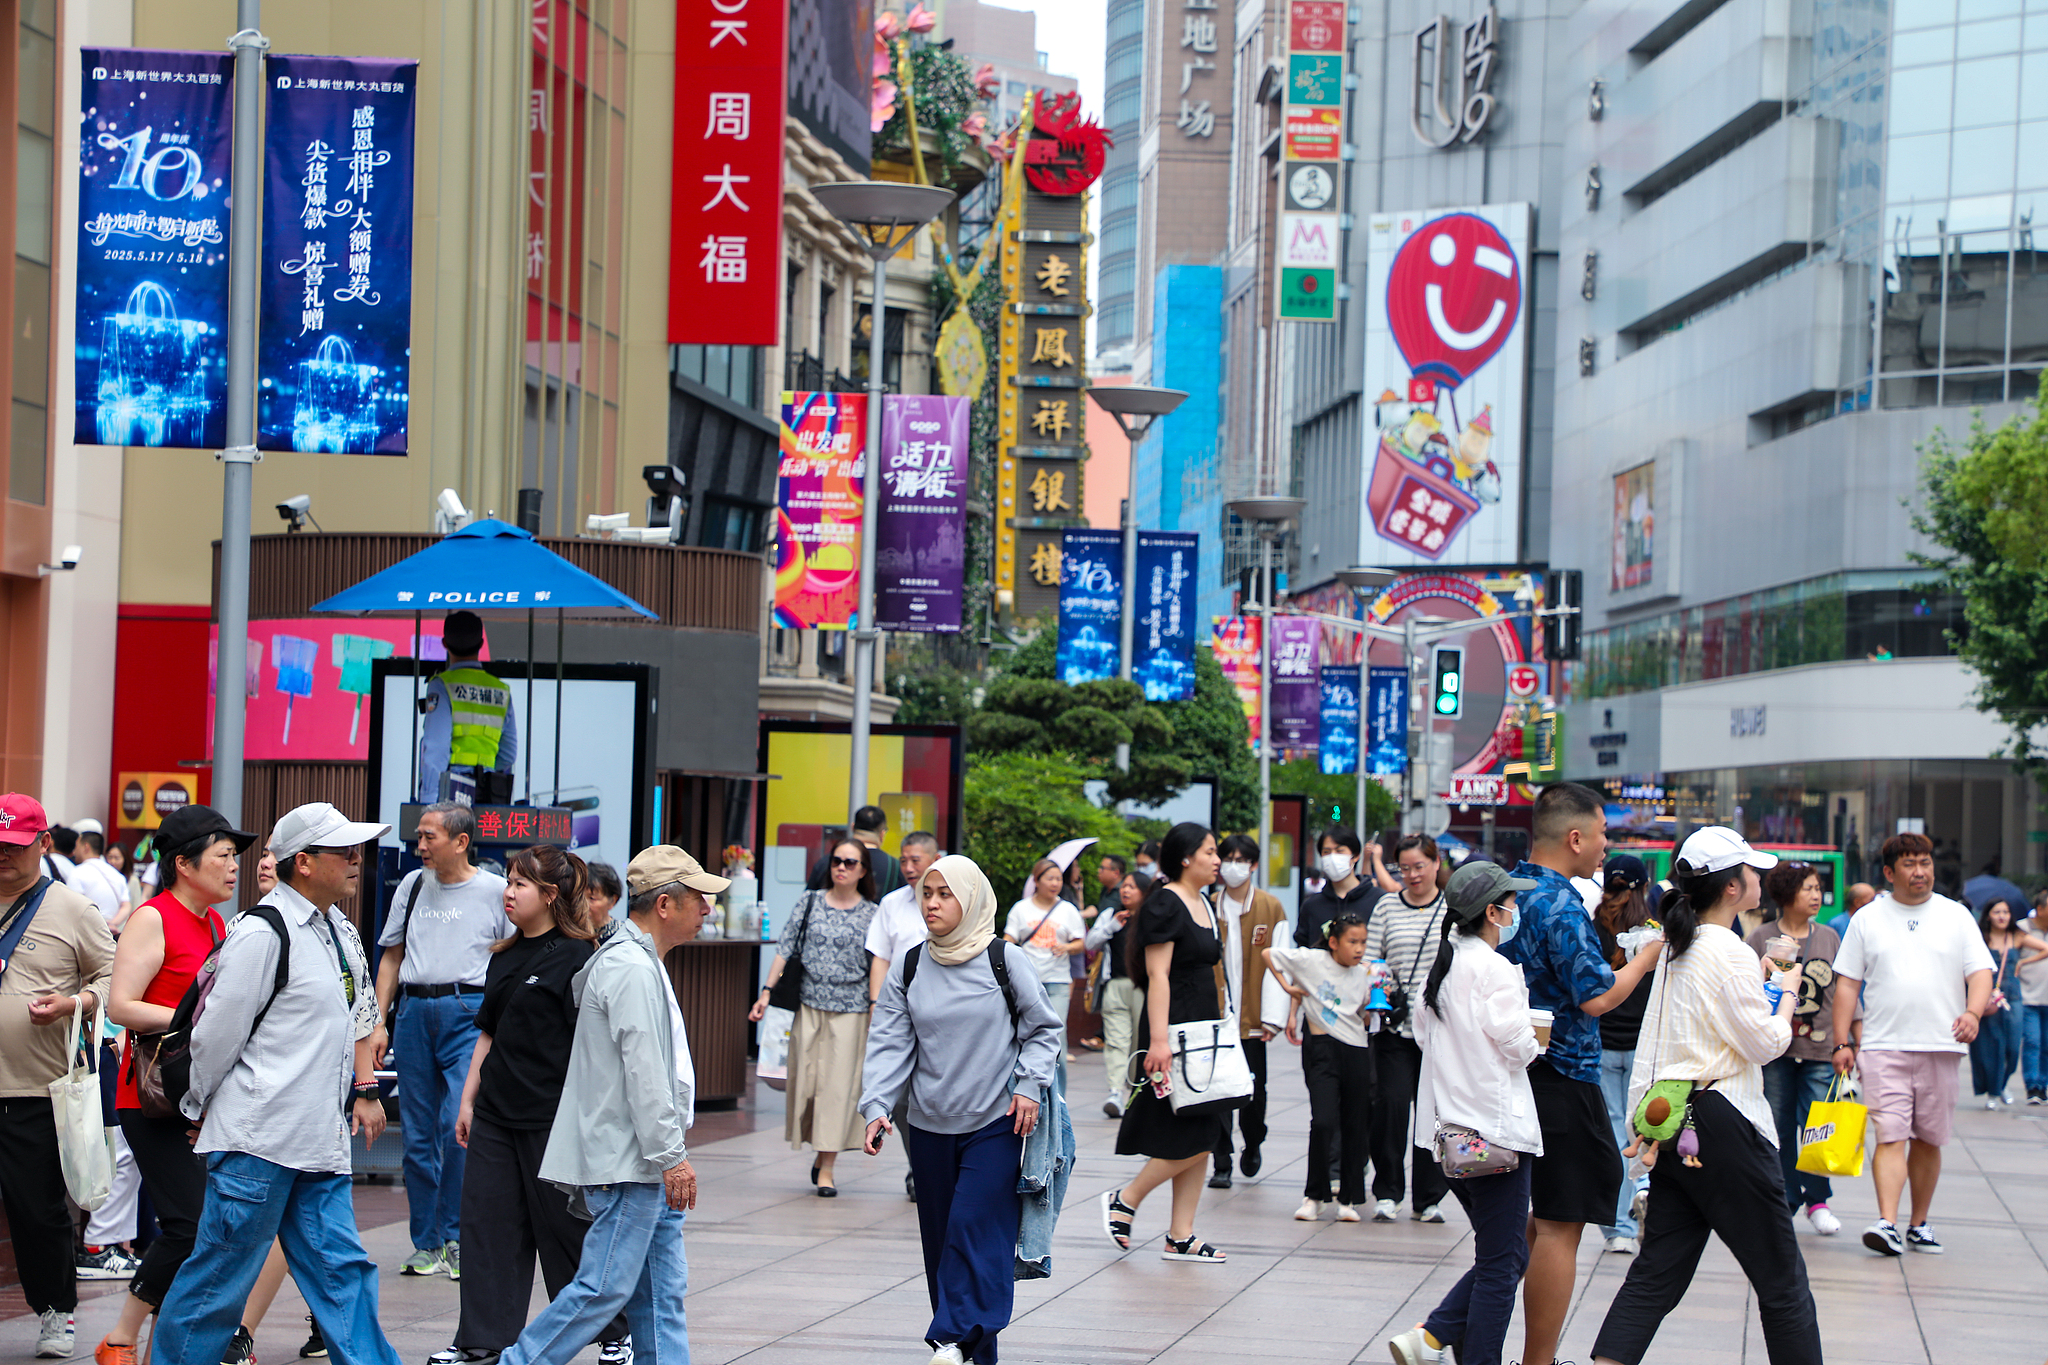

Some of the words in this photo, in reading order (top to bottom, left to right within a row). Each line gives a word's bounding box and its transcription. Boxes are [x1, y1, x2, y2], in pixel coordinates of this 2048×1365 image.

[110, 69, 222, 85] 上海新世界大丸百货
[1177, 0, 1219, 138] 地广场
[294, 77, 405, 93] 上海新世界大丸百货
[337, 105, 391, 203] 感恩相伴
[300, 139, 352, 230] 尖货爆款
[699, 92, 751, 284] 周大福
[176, 252, 203, 263] 5.18
[334, 207, 380, 306] 大额赠券
[280, 241, 338, 337] 惊喜礼赠
[795, 429, 853, 455] 出发吧
[890, 440, 953, 470] 活力
[428, 592, 520, 603] POLICE
[454, 685, 505, 706] 公安辅警
[1450, 780, 1499, 798] LAND
[419, 905, 462, 924] Google
